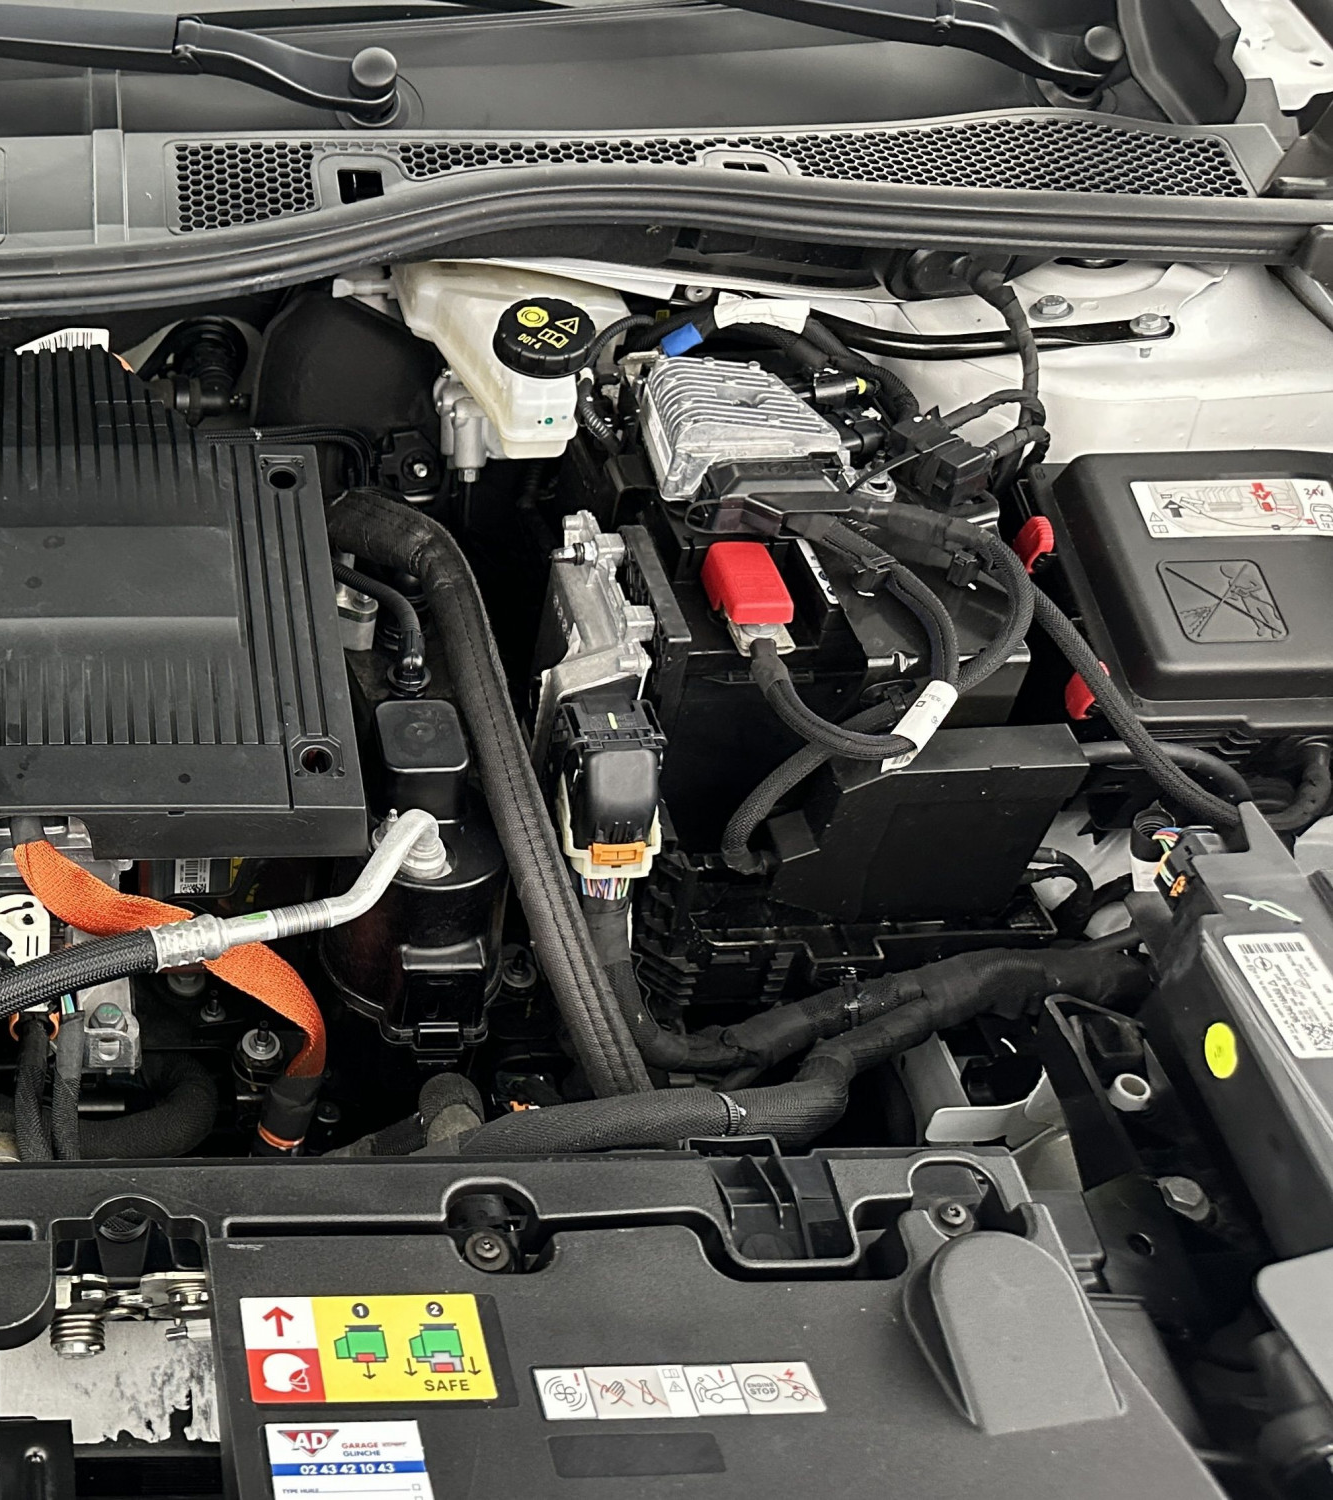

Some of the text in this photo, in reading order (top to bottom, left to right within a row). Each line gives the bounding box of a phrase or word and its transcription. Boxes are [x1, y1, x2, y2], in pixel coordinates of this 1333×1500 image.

[517, 333, 536, 346] DOT
[356, 1304, 440, 1317] 1 2
[424, 1379, 470, 1392] SAFE
[749, 1387, 776, 1395] STOP
[293, 1432, 329, 1450] AD
[341, 1442, 378, 1450] GARAGE
[300, 1462, 395, 1475] 02 43 42 10 43
